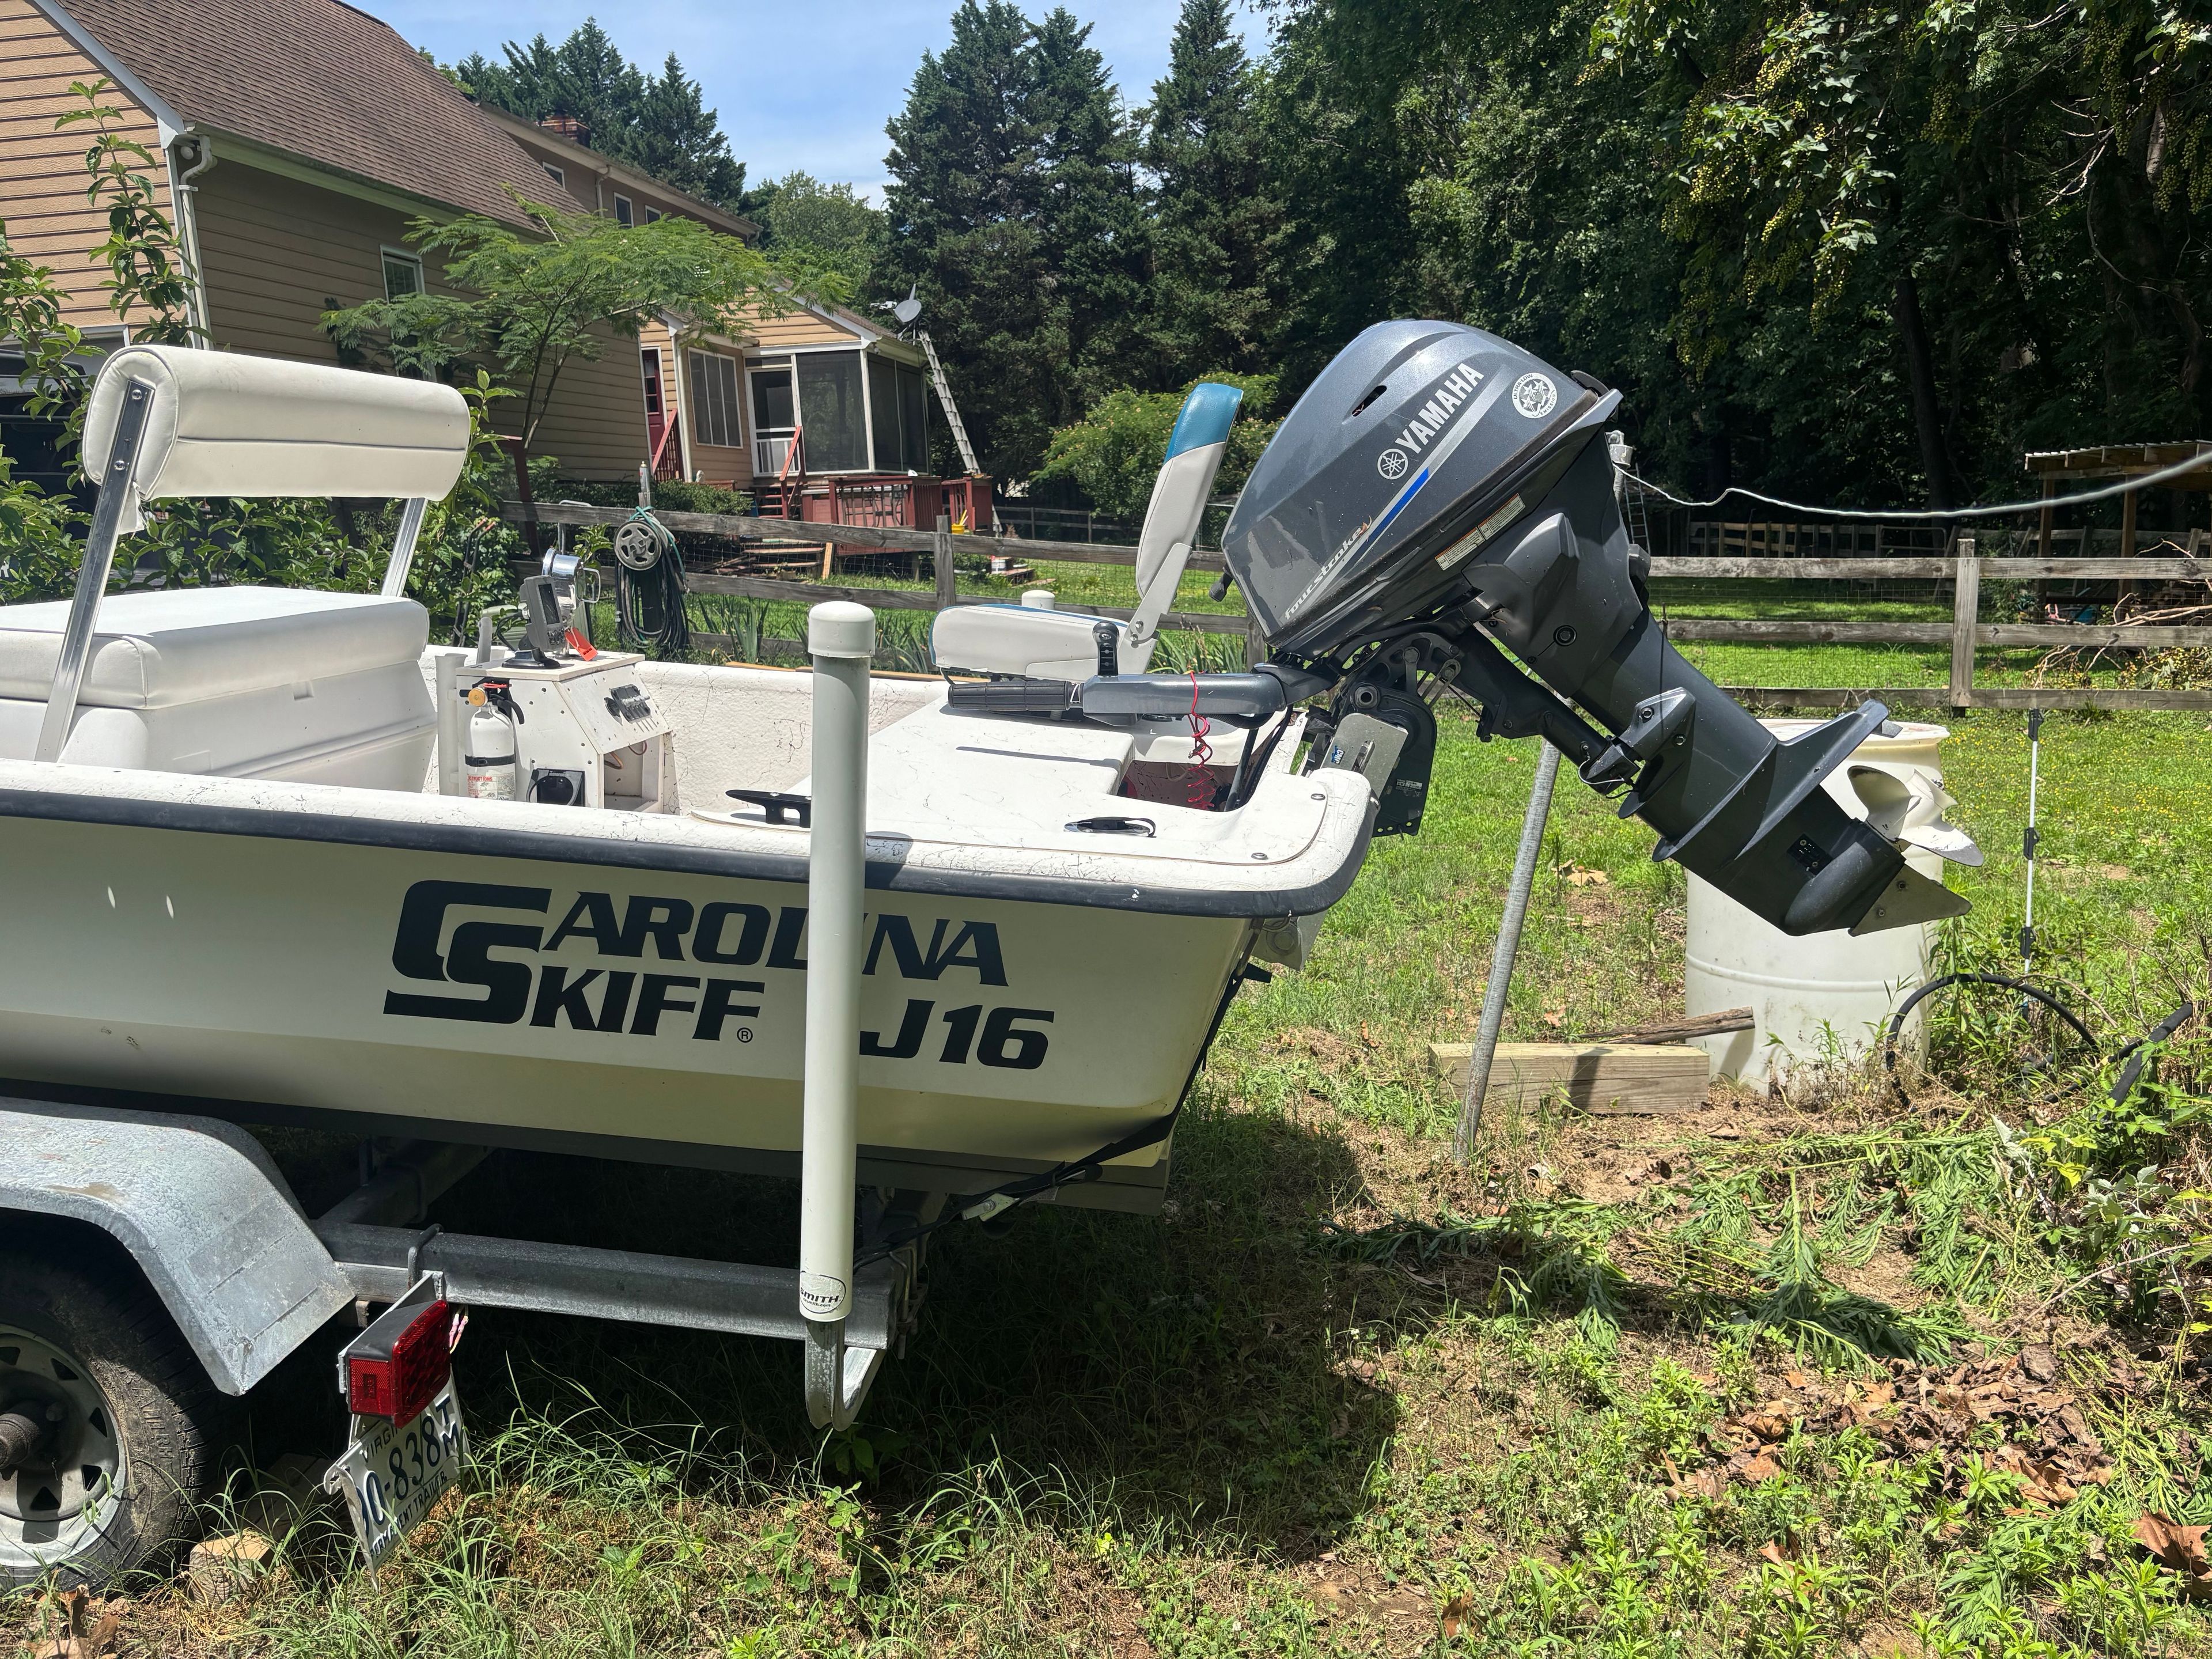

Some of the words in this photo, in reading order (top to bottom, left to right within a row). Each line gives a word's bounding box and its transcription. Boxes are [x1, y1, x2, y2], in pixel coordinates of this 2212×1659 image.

[1395, 362, 1484, 454] YAMAHA
[392, 880, 1008, 986] CAROLNA
[383, 921, 764, 1040] SKIFF
[859, 999, 1054, 1070] J16
[801, 1287, 839, 1303] SMITH
